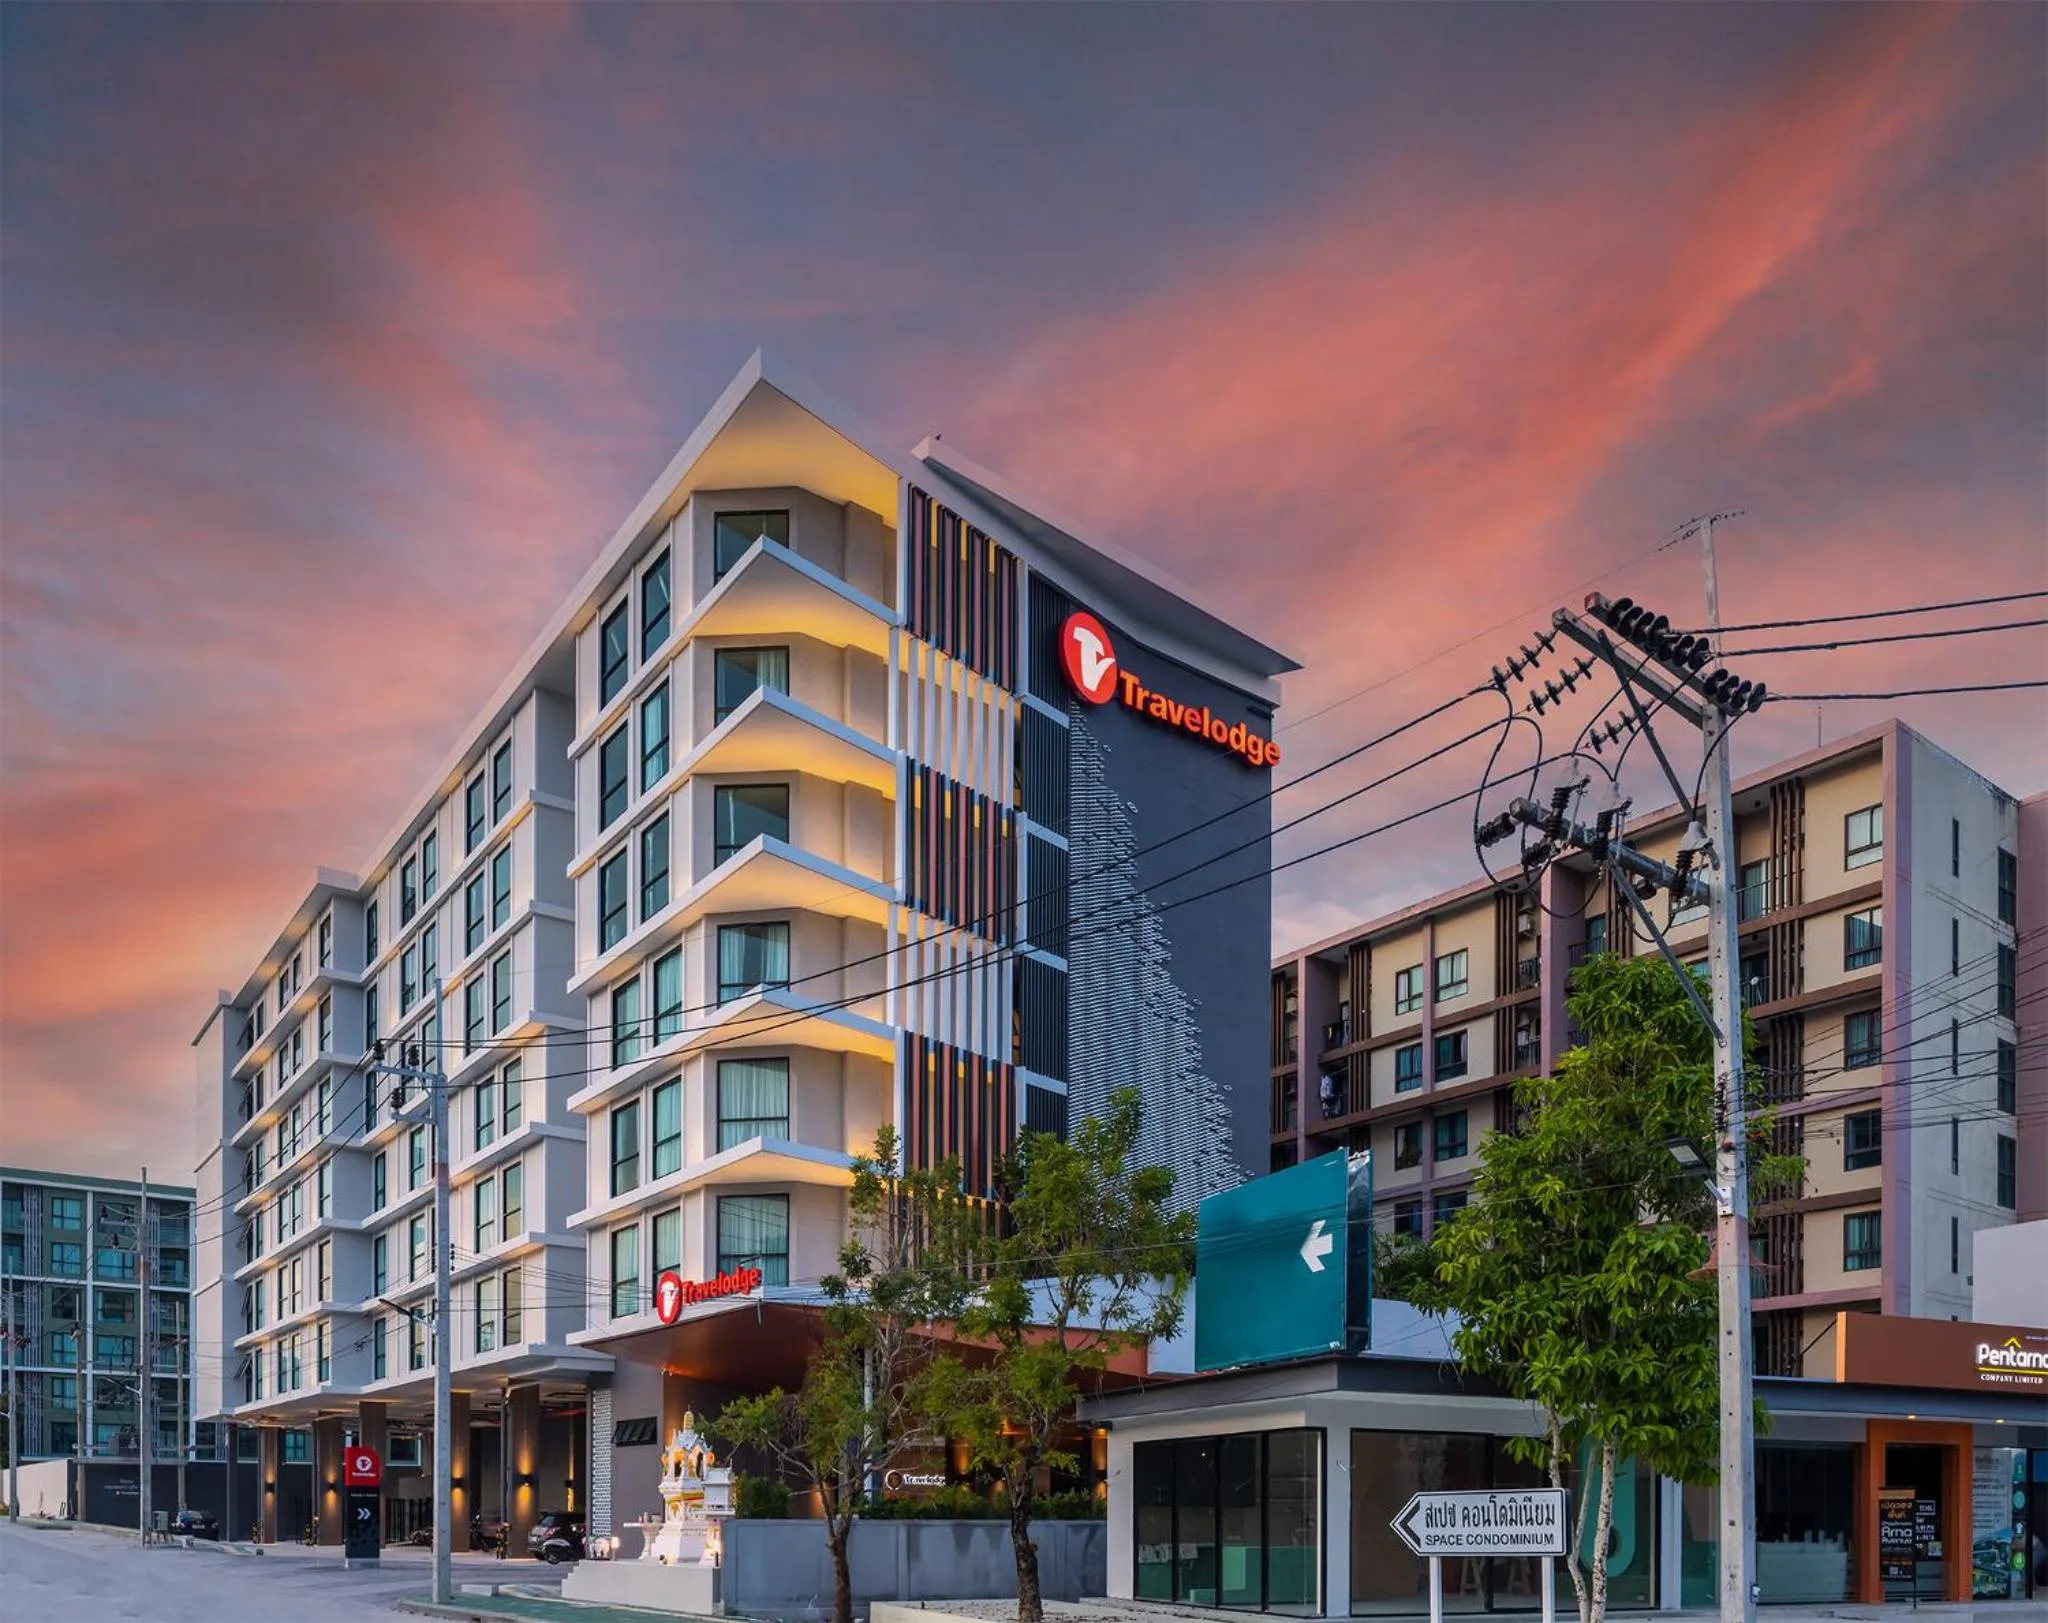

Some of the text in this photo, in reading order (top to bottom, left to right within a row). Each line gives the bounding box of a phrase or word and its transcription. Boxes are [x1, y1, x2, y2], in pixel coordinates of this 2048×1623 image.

[1119, 668, 1281, 767] Travelodge
[682, 1265, 762, 1304] Travelodge
[1981, 1373, 2043, 1384] COMPANY LIMITED
[1462, 1495, 1555, 1528] คอนโดมิเนียม
[1425, 1533, 1554, 1546] SPACE CONDOMINIUM
[1881, 1526, 1912, 1537] Arna
